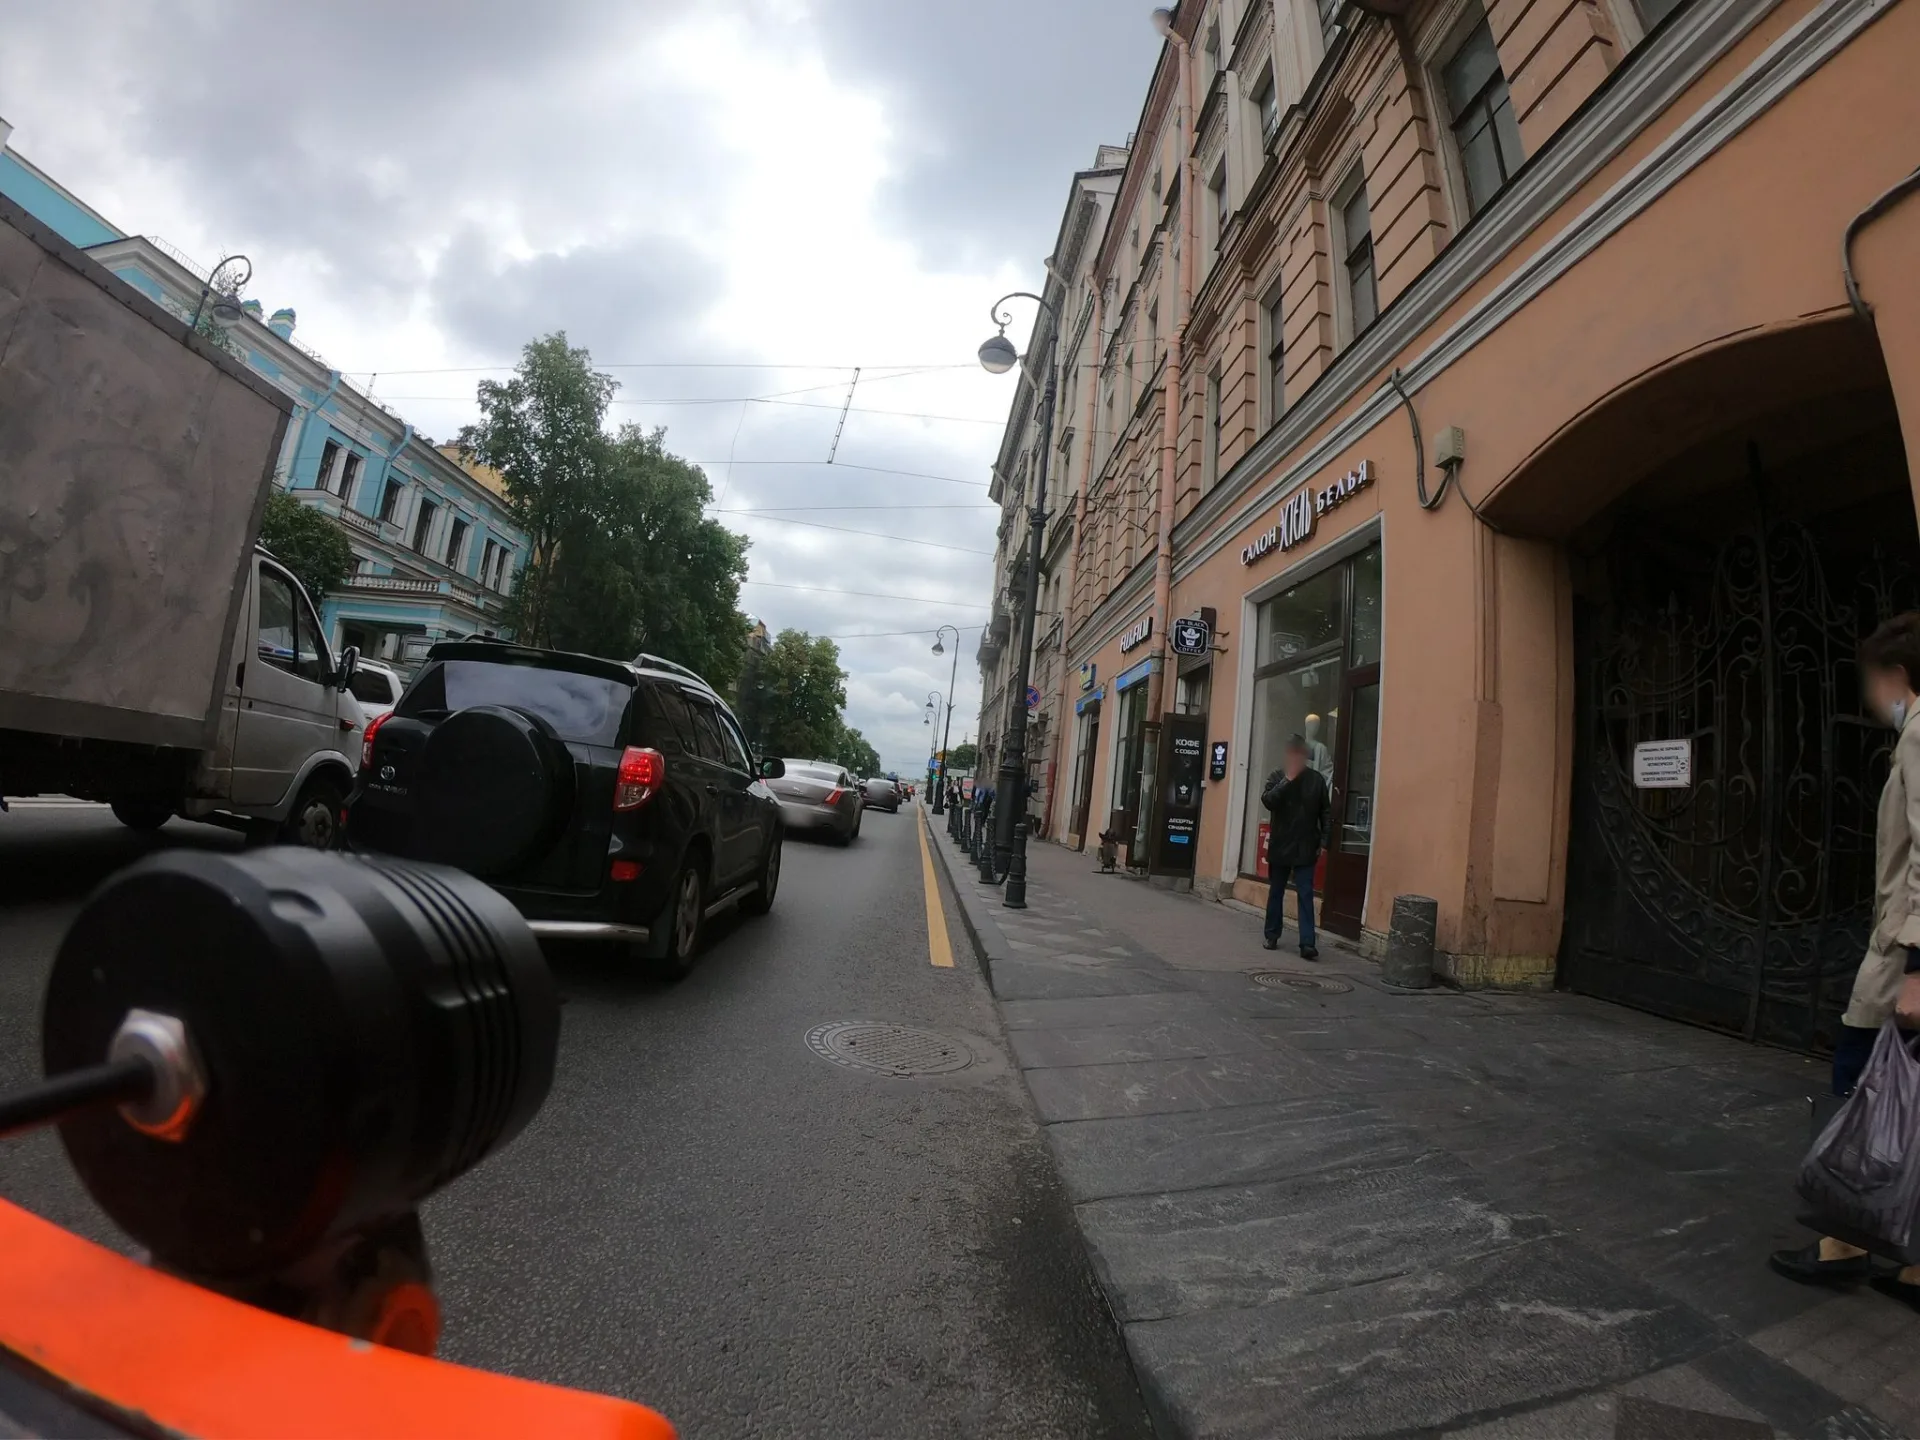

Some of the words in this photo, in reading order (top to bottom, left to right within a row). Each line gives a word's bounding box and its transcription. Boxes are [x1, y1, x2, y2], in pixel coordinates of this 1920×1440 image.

[1240, 526, 1278, 566] САЛОН
[1316, 459, 1370, 513] БЕЛЬЯ
[1175, 738, 1200, 747] КОФЕ
